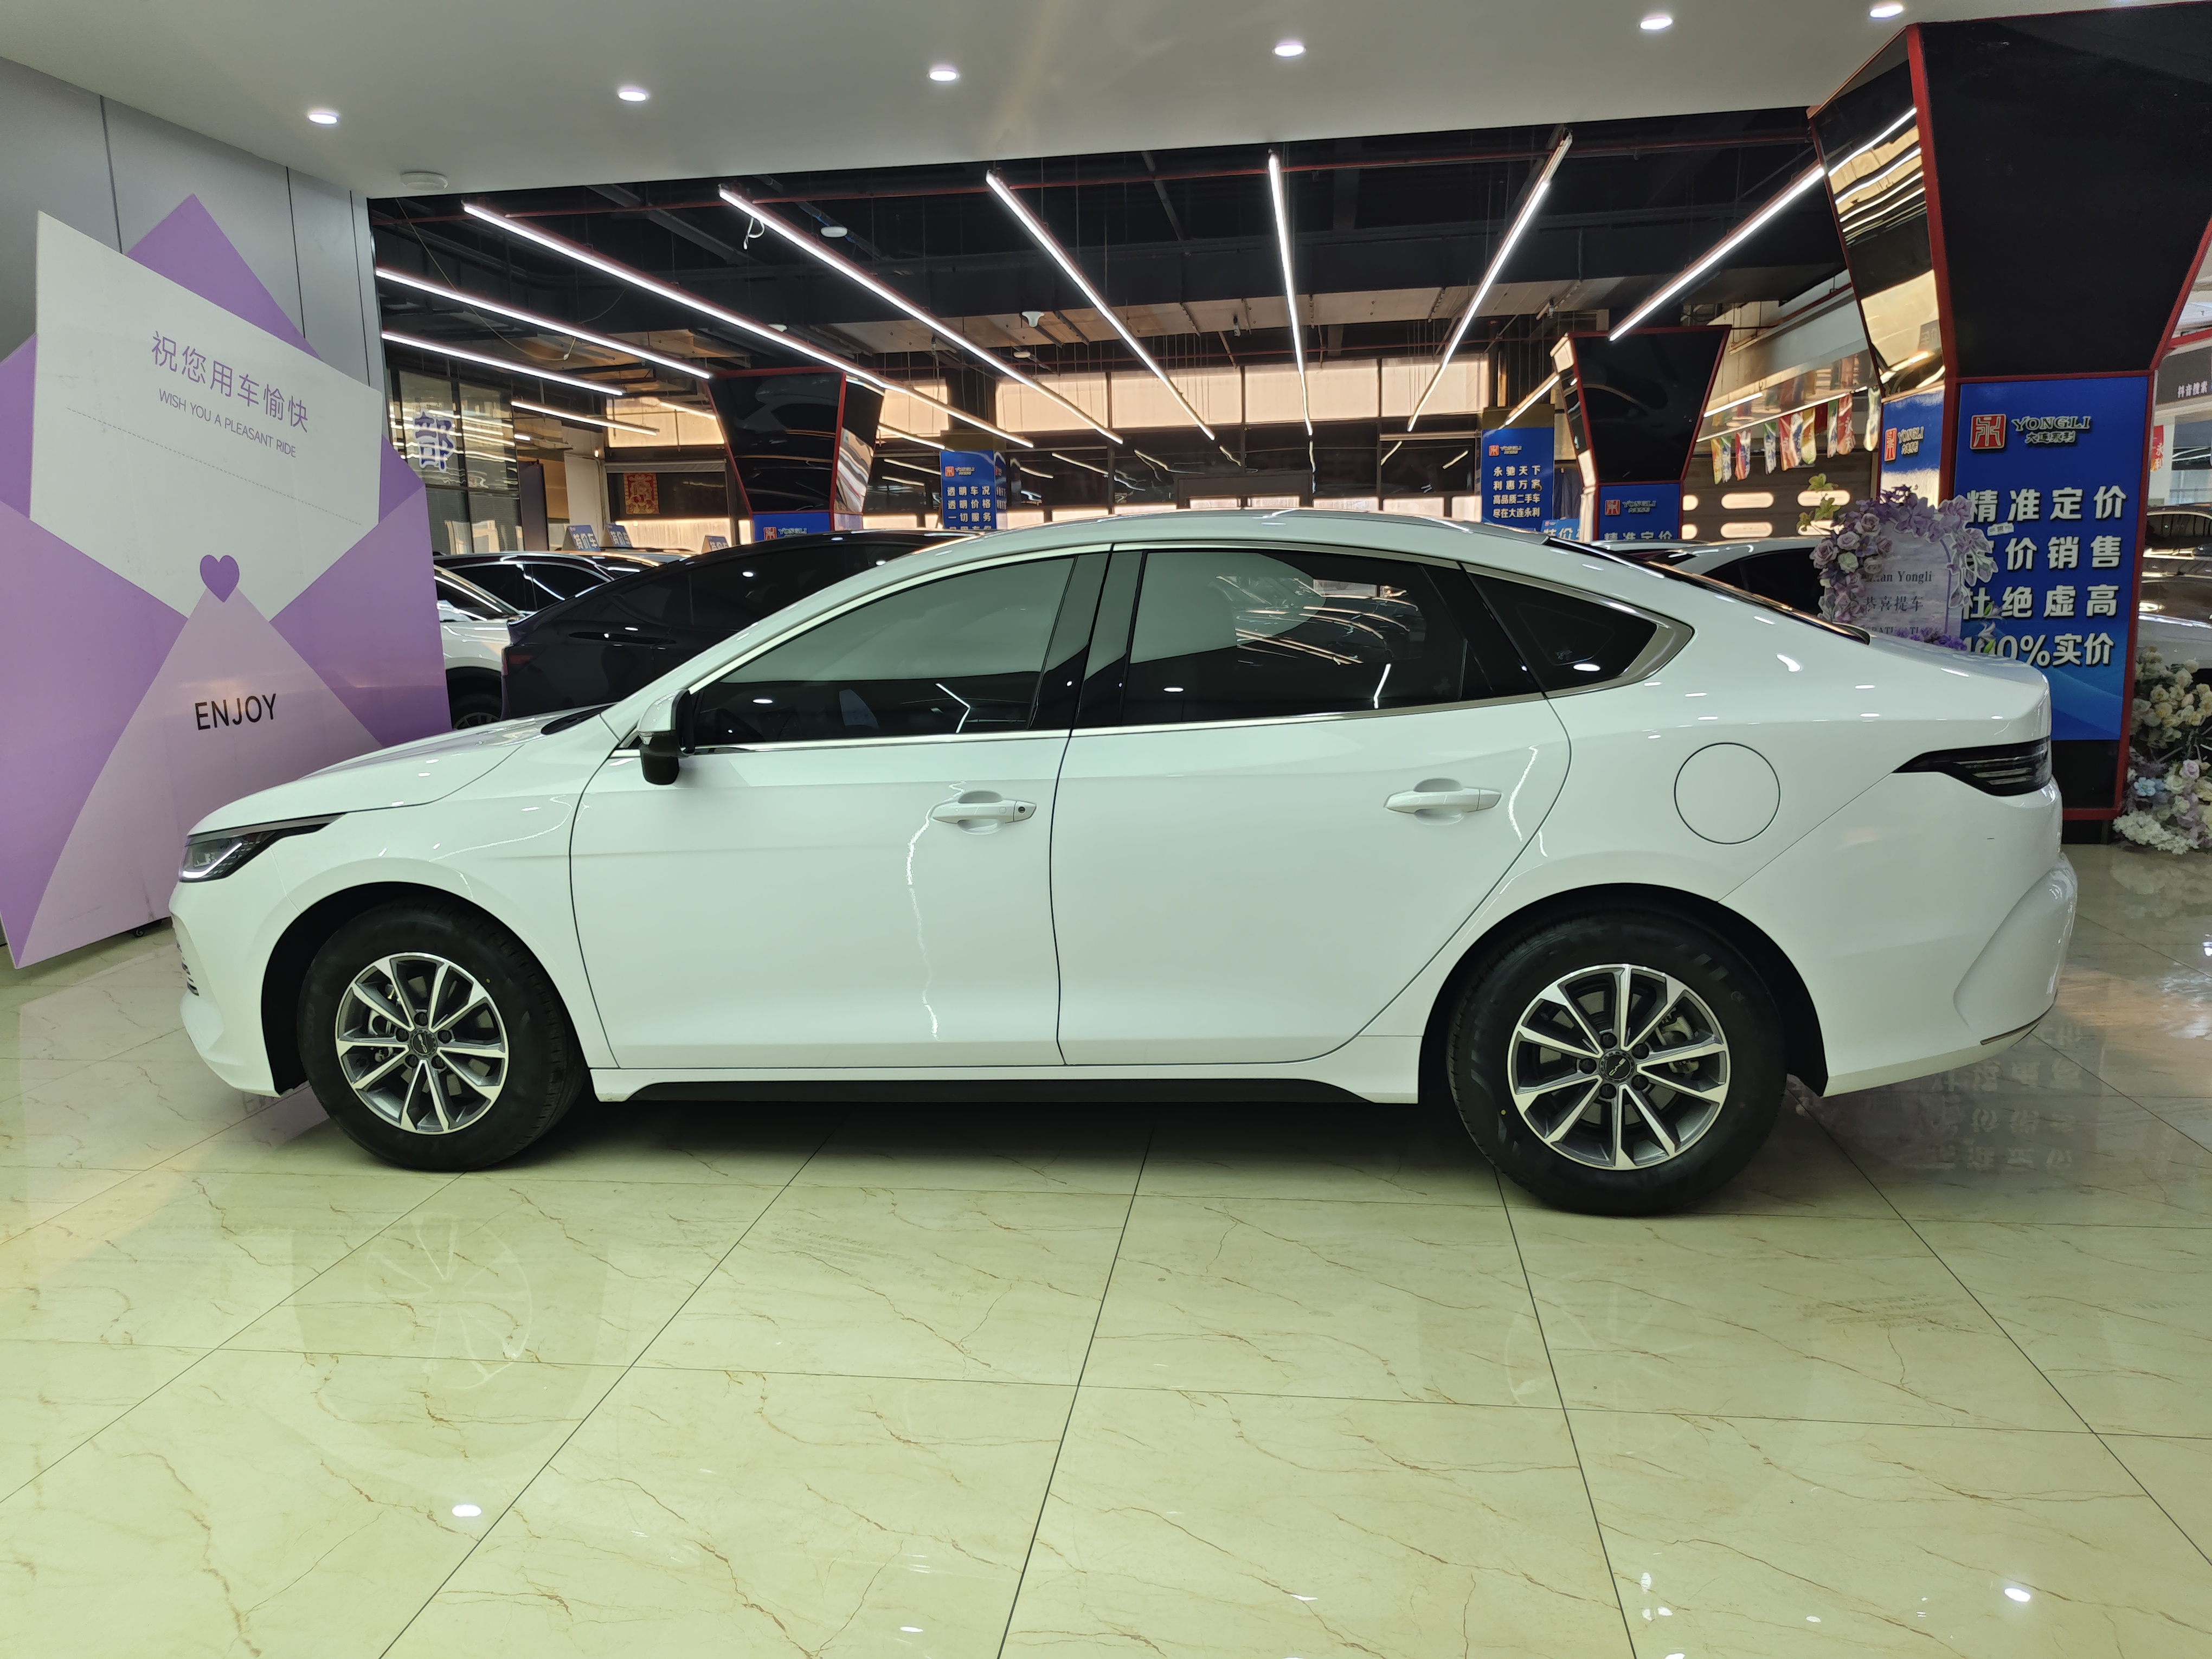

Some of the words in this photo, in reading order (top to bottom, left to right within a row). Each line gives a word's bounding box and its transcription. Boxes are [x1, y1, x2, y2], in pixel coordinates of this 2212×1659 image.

[152, 330, 308, 433] 祝您用车愉快
[159, 388, 187, 412] WISH
[190, 402, 211, 422] YOU
[214, 414, 222, 427] A
[224, 417, 274, 448] PLEASANT
[276, 439, 297, 458] RIDE
[2011, 416, 2091, 432] YONGLI
[1494, 465, 1541, 477] 永驰天下
[947, 486, 991, 497] 透明车况
[948, 499, 991, 510] 透明价格
[1493, 493, 1540, 505] 高品质二手车
[1966, 485, 2127, 523] 精准定价
[948, 512, 992, 523] 一切服务
[1493, 507, 1540, 519] 尽在大连永利
[1543, 528, 1580, 540] 特价
[1966, 535, 2123, 570] 价销售
[1898, 571, 1932, 584] Yongli
[1865, 596, 1924, 612] 恭喜提车
[195, 693, 276, 730] ENJOY
